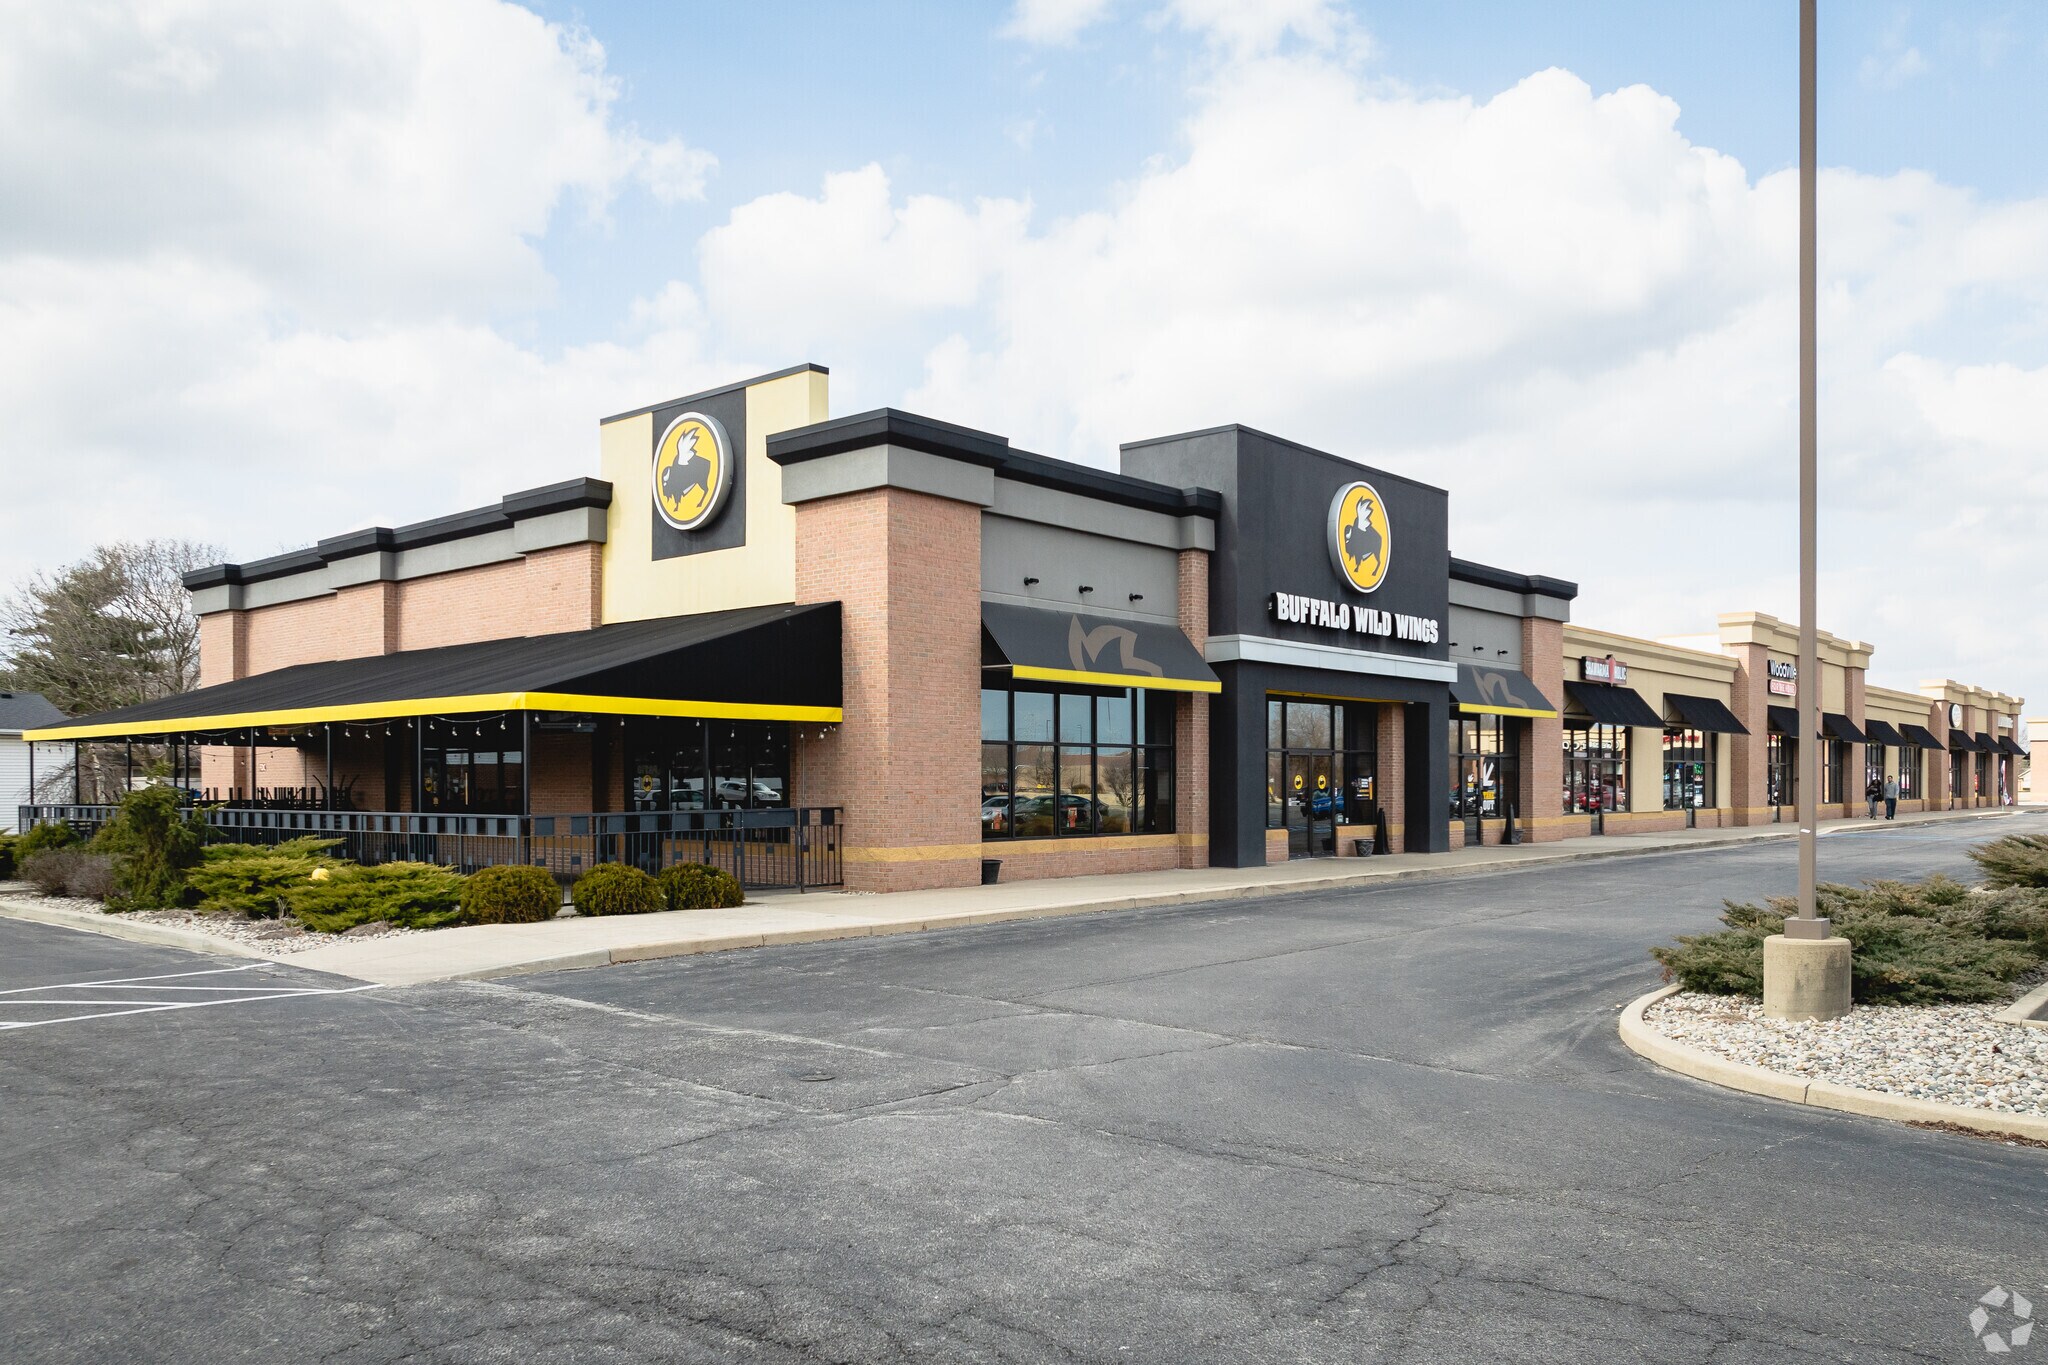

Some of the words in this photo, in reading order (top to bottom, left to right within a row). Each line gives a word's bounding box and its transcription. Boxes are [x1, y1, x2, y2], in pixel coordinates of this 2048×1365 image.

[1276, 592, 1350, 631] BUFFALO
[1353, 606, 1392, 637] WILD
[1394, 613, 1439, 644] WINGS
[1483, 799, 1495, 810] OUT
